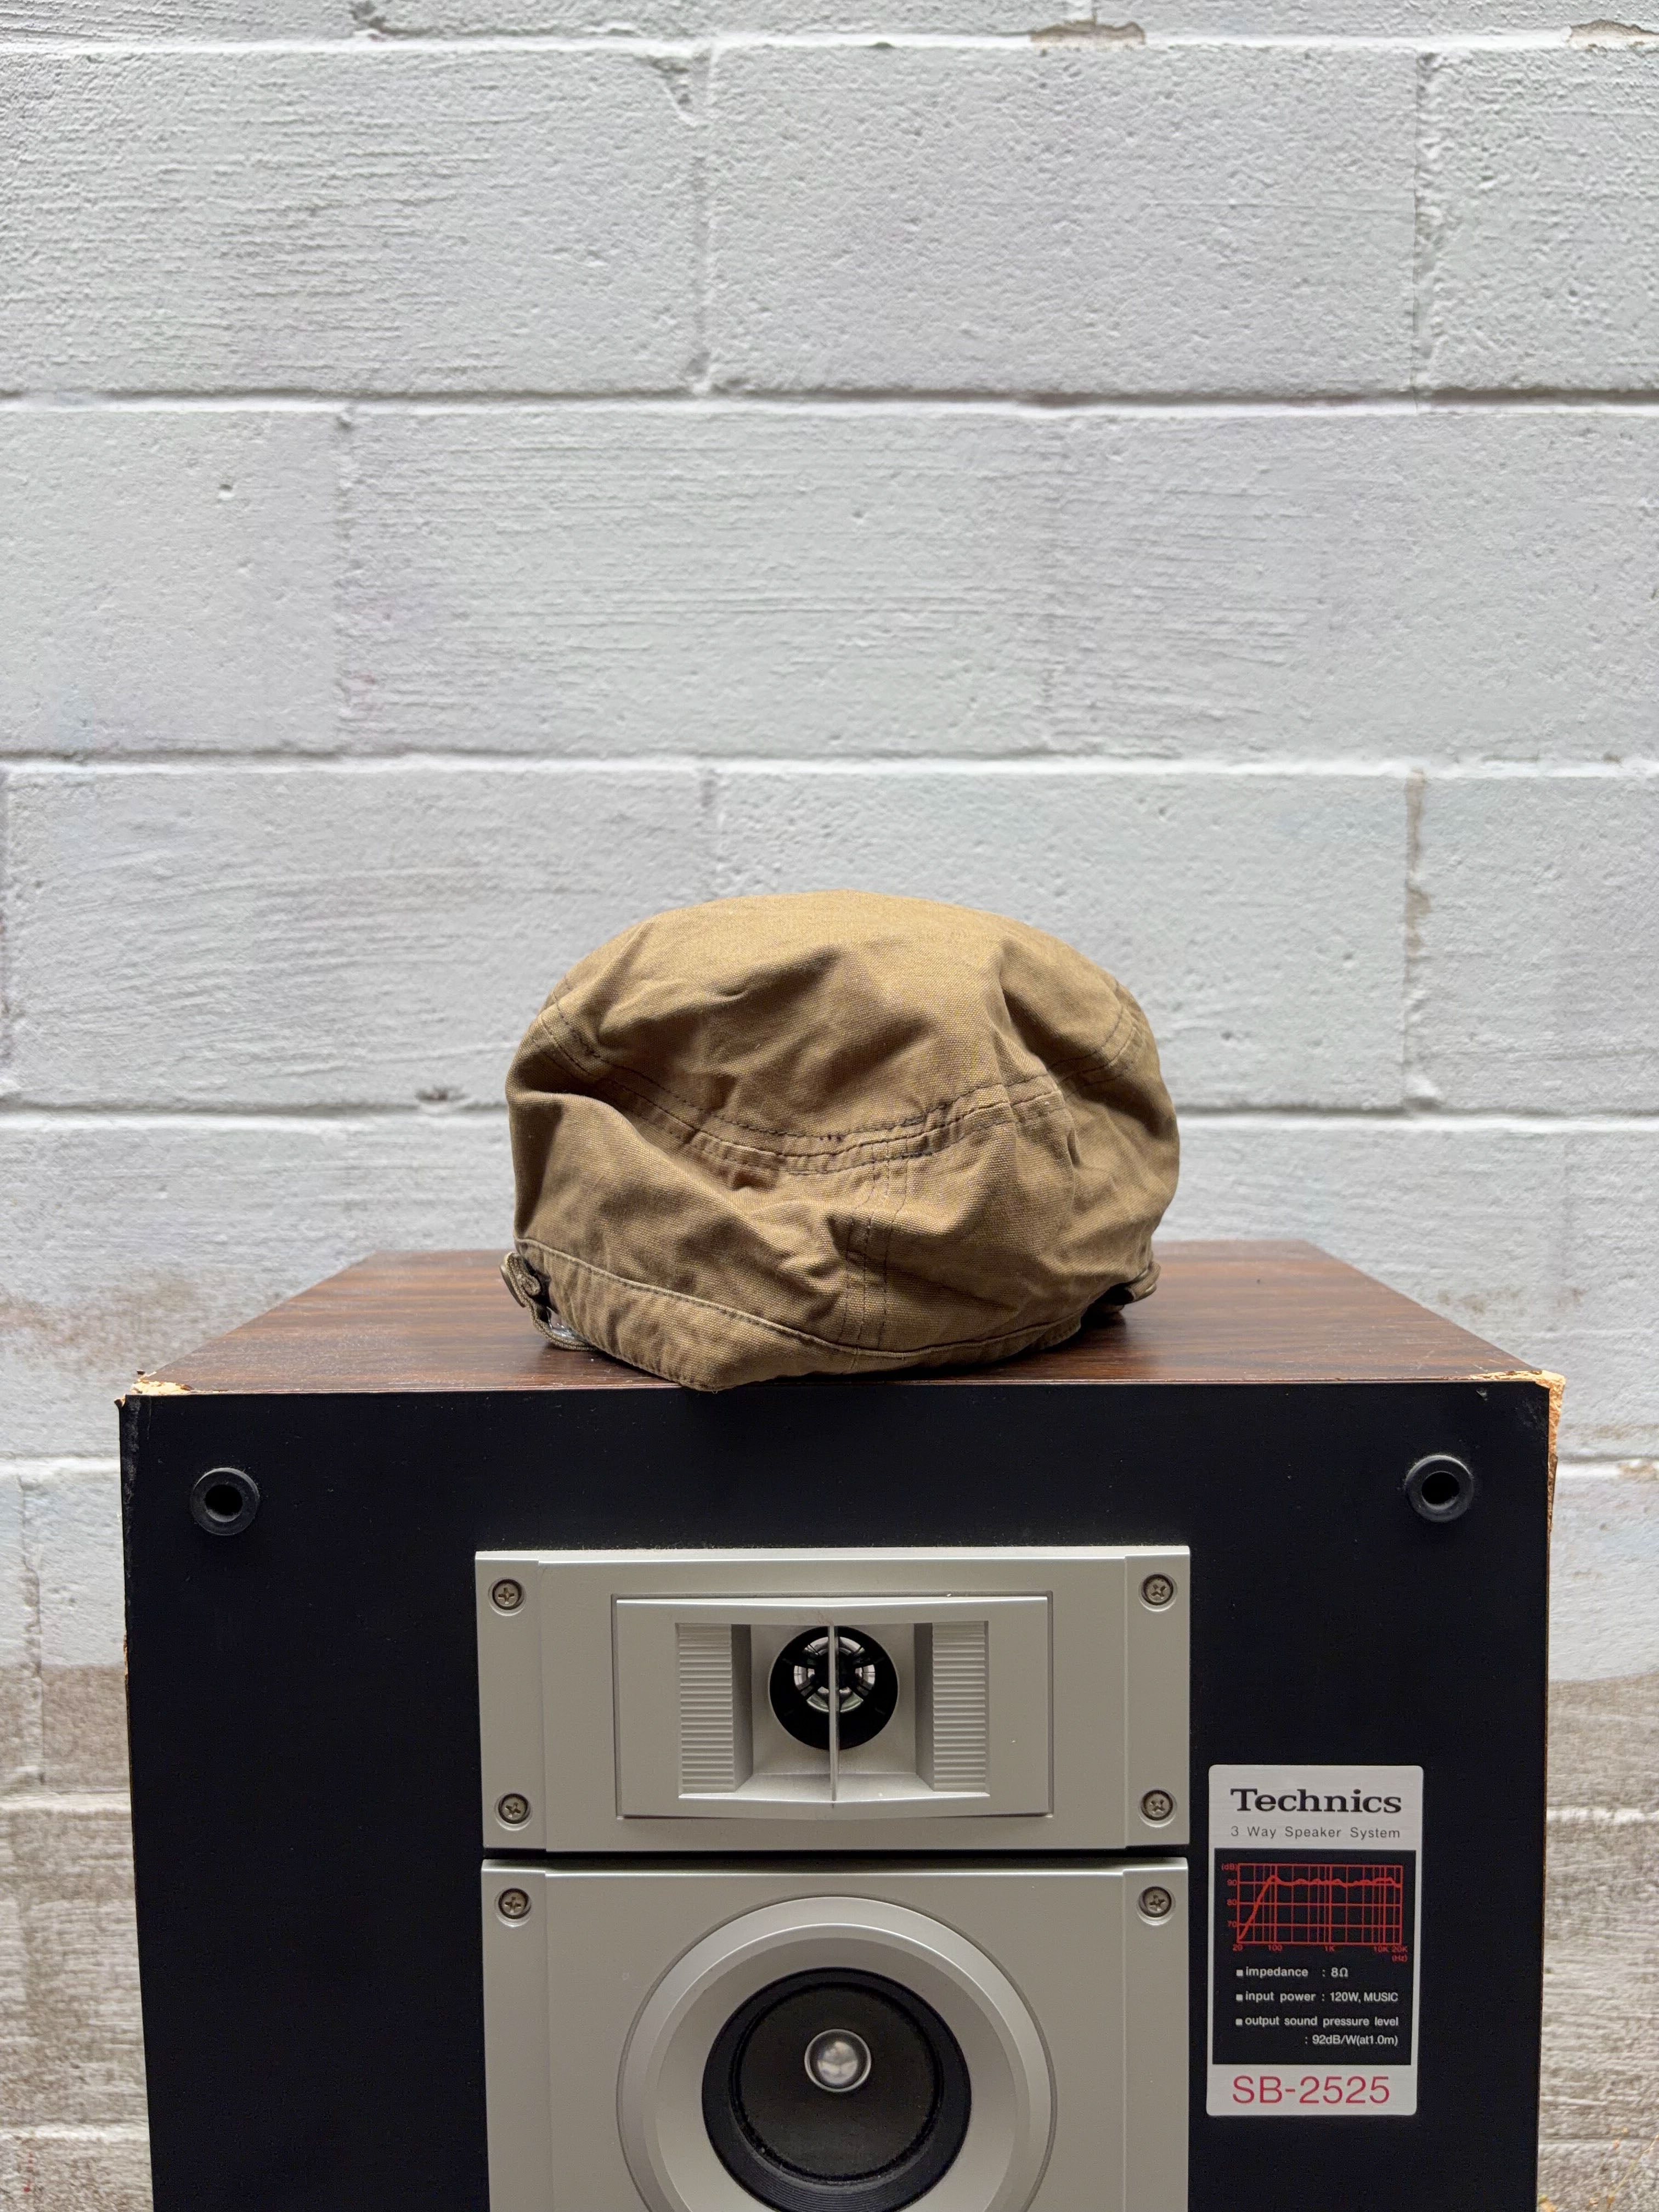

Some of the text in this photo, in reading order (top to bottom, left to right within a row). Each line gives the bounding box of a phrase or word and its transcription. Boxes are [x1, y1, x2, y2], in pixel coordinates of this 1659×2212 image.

[1230, 1788, 1402, 1813] Technics
[1231, 1826, 1400, 1839] 3 Way Speaker System
[1245, 1967, 1308, 1978] impedance
[1245, 1991, 1274, 2003] input
[1280, 1993, 1316, 2003] power
[1330, 1992, 1362, 2003] 120W,
[1364, 1992, 1398, 2002] MUSIC
[1245, 2017, 1399, 2028] output sound pressure level
[1232, 2075, 1390, 2104] SB-2525
